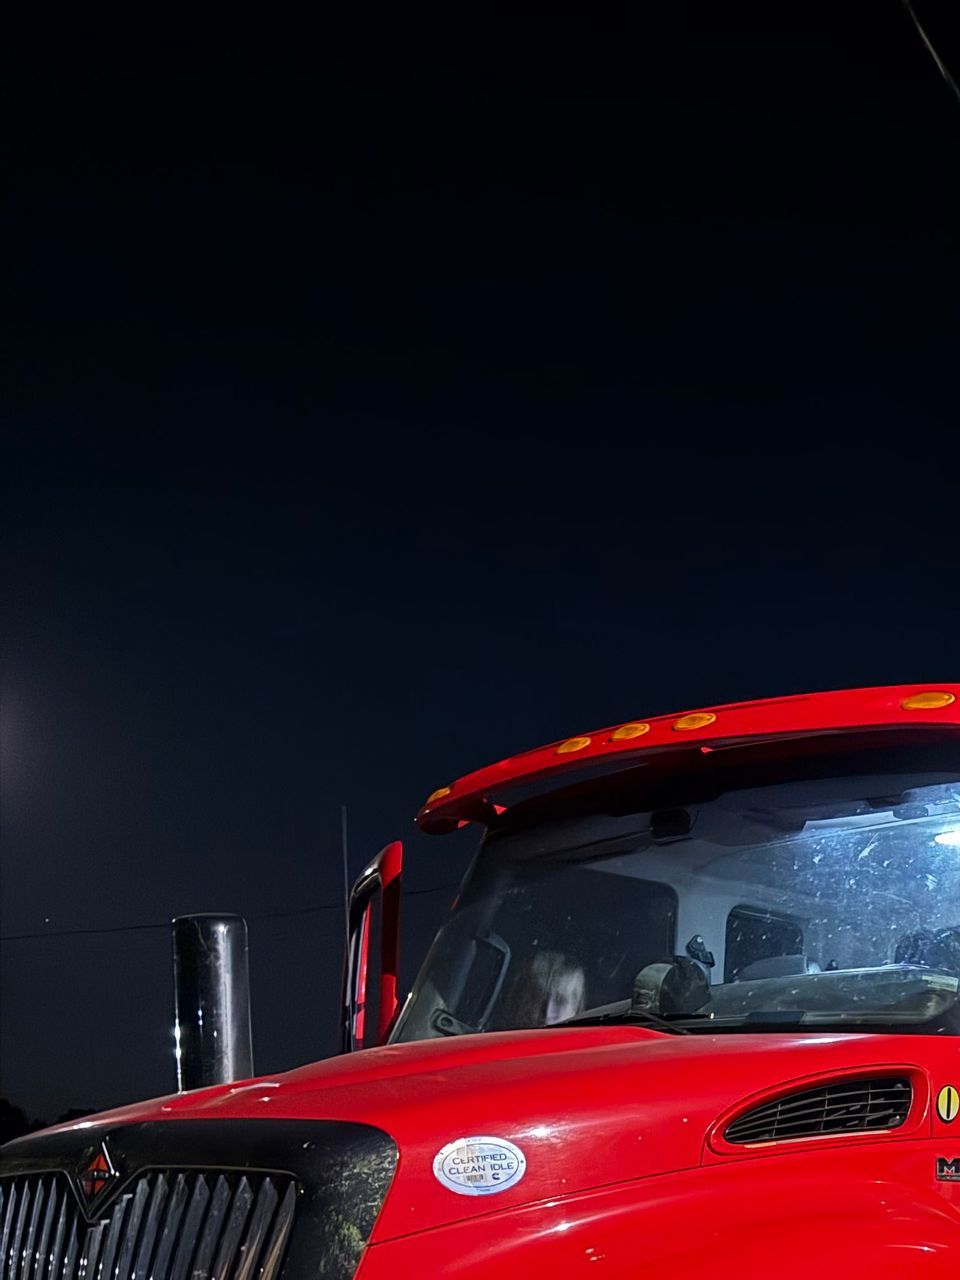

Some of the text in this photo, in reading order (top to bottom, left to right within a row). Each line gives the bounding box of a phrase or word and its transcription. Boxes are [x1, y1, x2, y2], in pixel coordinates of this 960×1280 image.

[452, 1153, 508, 1166] CERTIFIED
[448, 1161, 515, 1175] CLEAN IDLE
